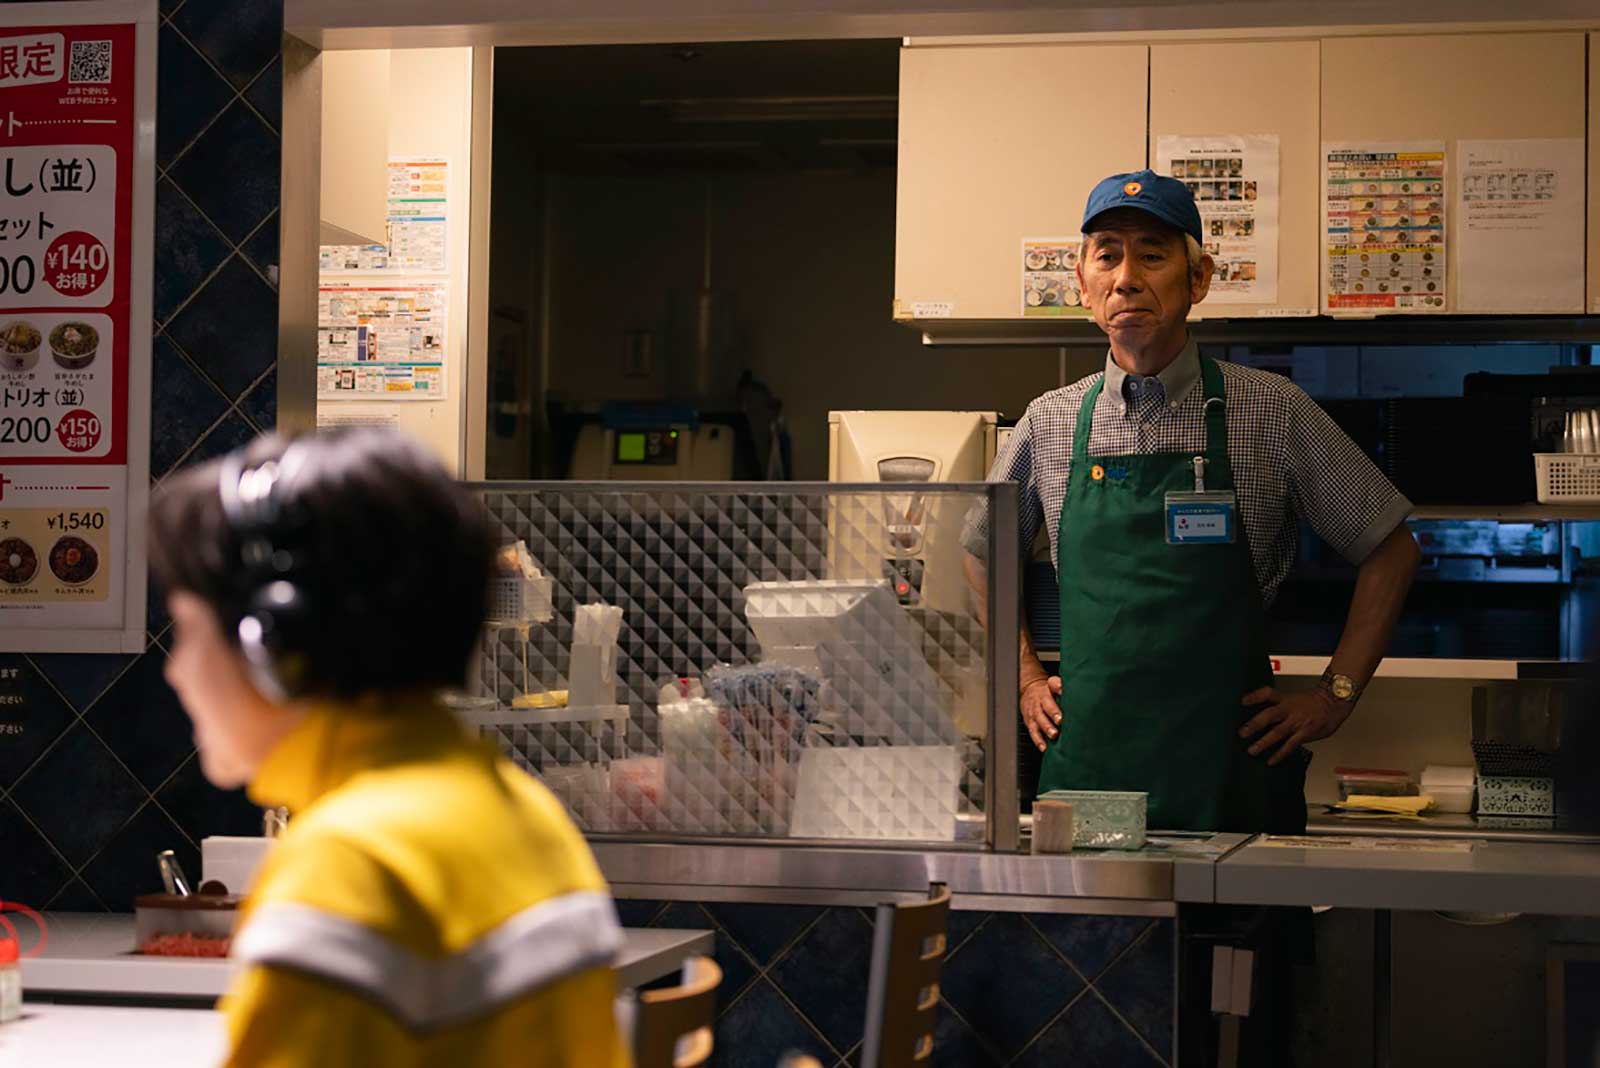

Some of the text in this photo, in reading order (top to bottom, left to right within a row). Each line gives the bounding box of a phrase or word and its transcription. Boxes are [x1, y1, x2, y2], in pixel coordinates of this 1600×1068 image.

[47, 243, 106, 271] ¥140
[55, 272, 96, 290] お得!
[60, 418, 99, 436] ¥150
[66, 437, 93, 448] お得!
[47, 512, 104, 532] ¥1,540
